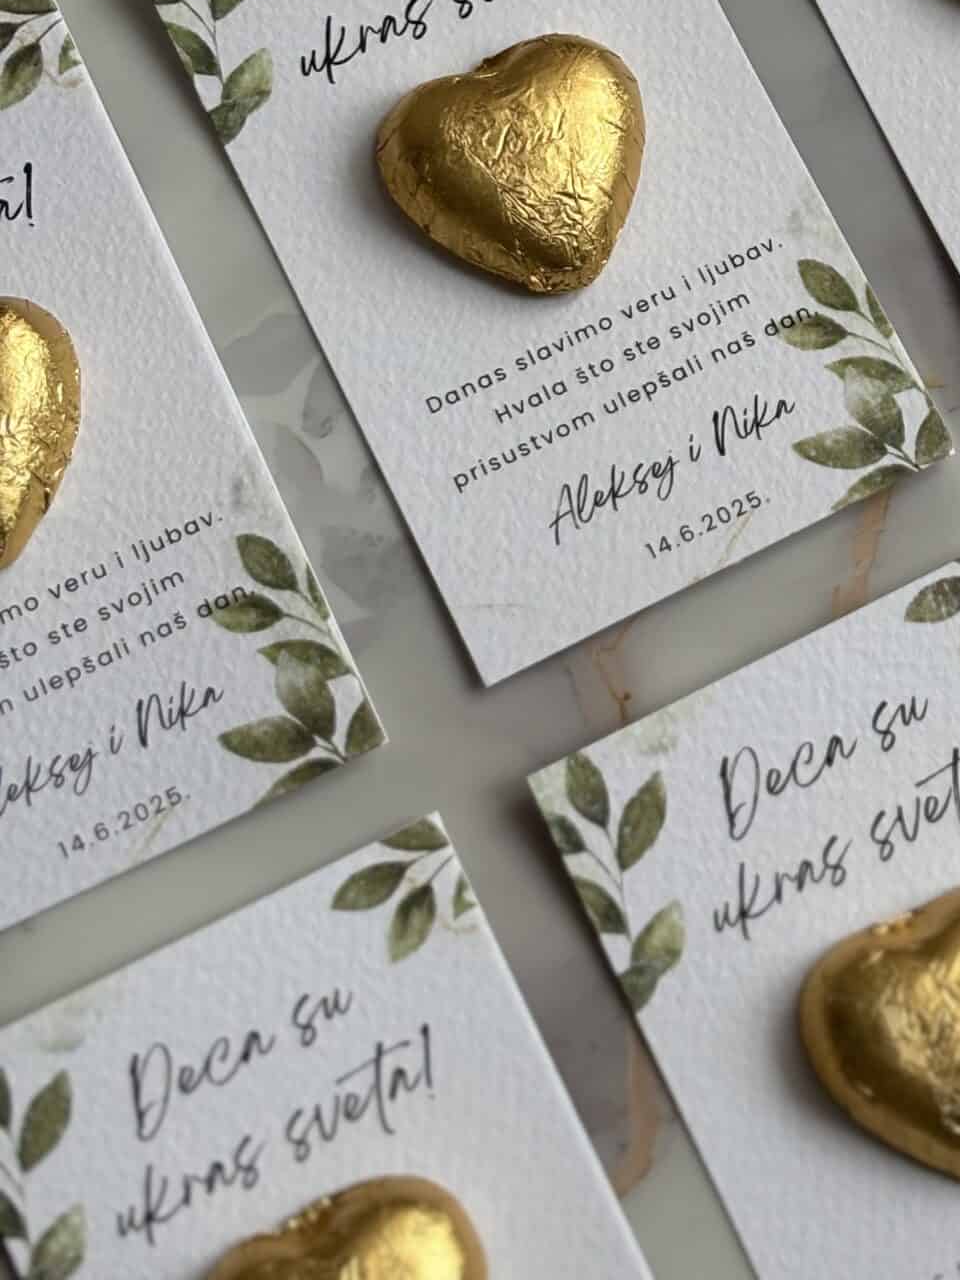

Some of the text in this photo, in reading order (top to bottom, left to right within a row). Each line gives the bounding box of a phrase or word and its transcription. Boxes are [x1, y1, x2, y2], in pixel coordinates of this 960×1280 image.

[425, 238, 783, 414] Danas slavimo veru i ljubav.
[494, 293, 750, 424] Hvala što ste svojim
[453, 411, 595, 494] prisustvom
[603, 355, 703, 414] ulepšali
[710, 330, 755, 363] naš
[548, 394, 795, 546] Aleksej i Nika
[48, 563, 107, 599] veru
[115, 550, 125, 571] i
[644, 491, 771, 560] 14.6.2025.
[23, 639, 130, 702] ulepšali
[139, 611, 187, 647] naš
[48, 617, 87, 645] ste
[97, 572, 184, 621] svojim
[0, 681, 223, 818] eksej i Nika
[129, 988, 352, 1143] Deca su
[117, 1023, 434, 1247] ukras sveta!
